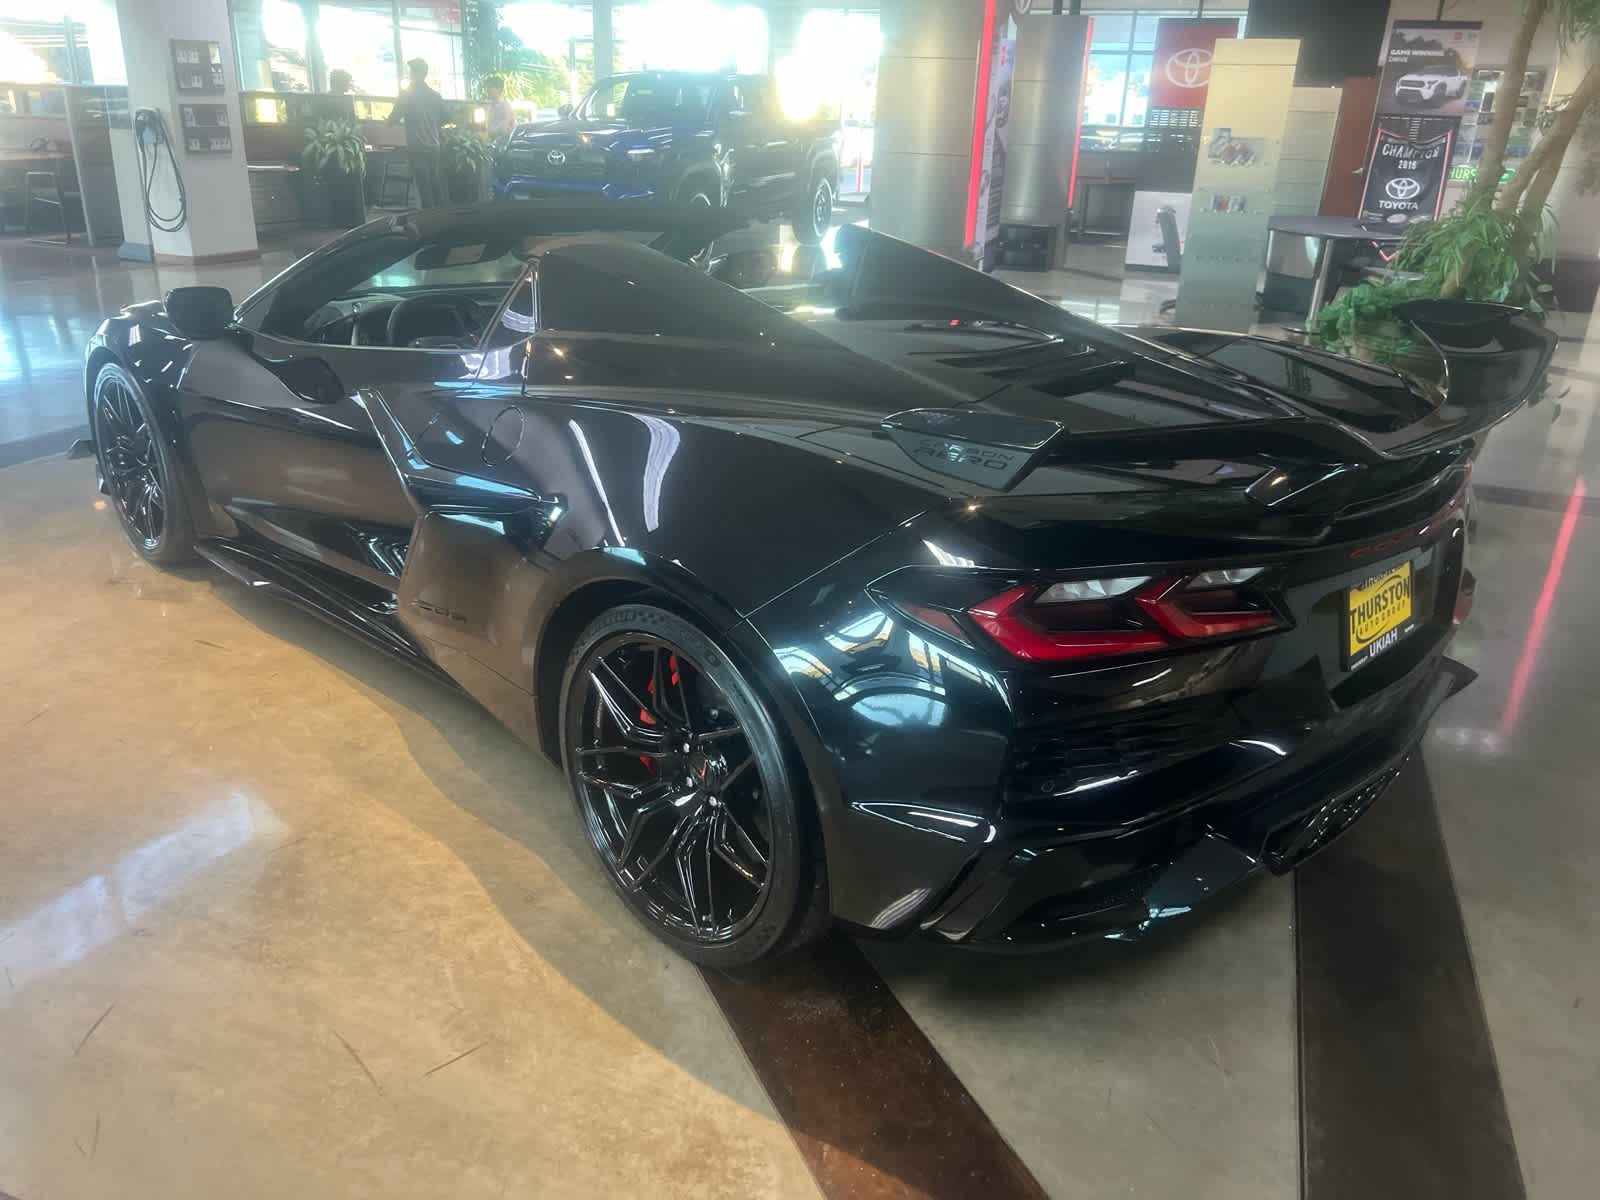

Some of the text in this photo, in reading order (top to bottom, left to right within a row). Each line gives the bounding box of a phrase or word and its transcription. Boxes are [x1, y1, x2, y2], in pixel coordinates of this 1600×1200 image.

[1379, 200, 1419, 211] TOYOTA
[1349, 576, 1410, 635] THURSTON
[1369, 628, 1398, 657] UKIAH
